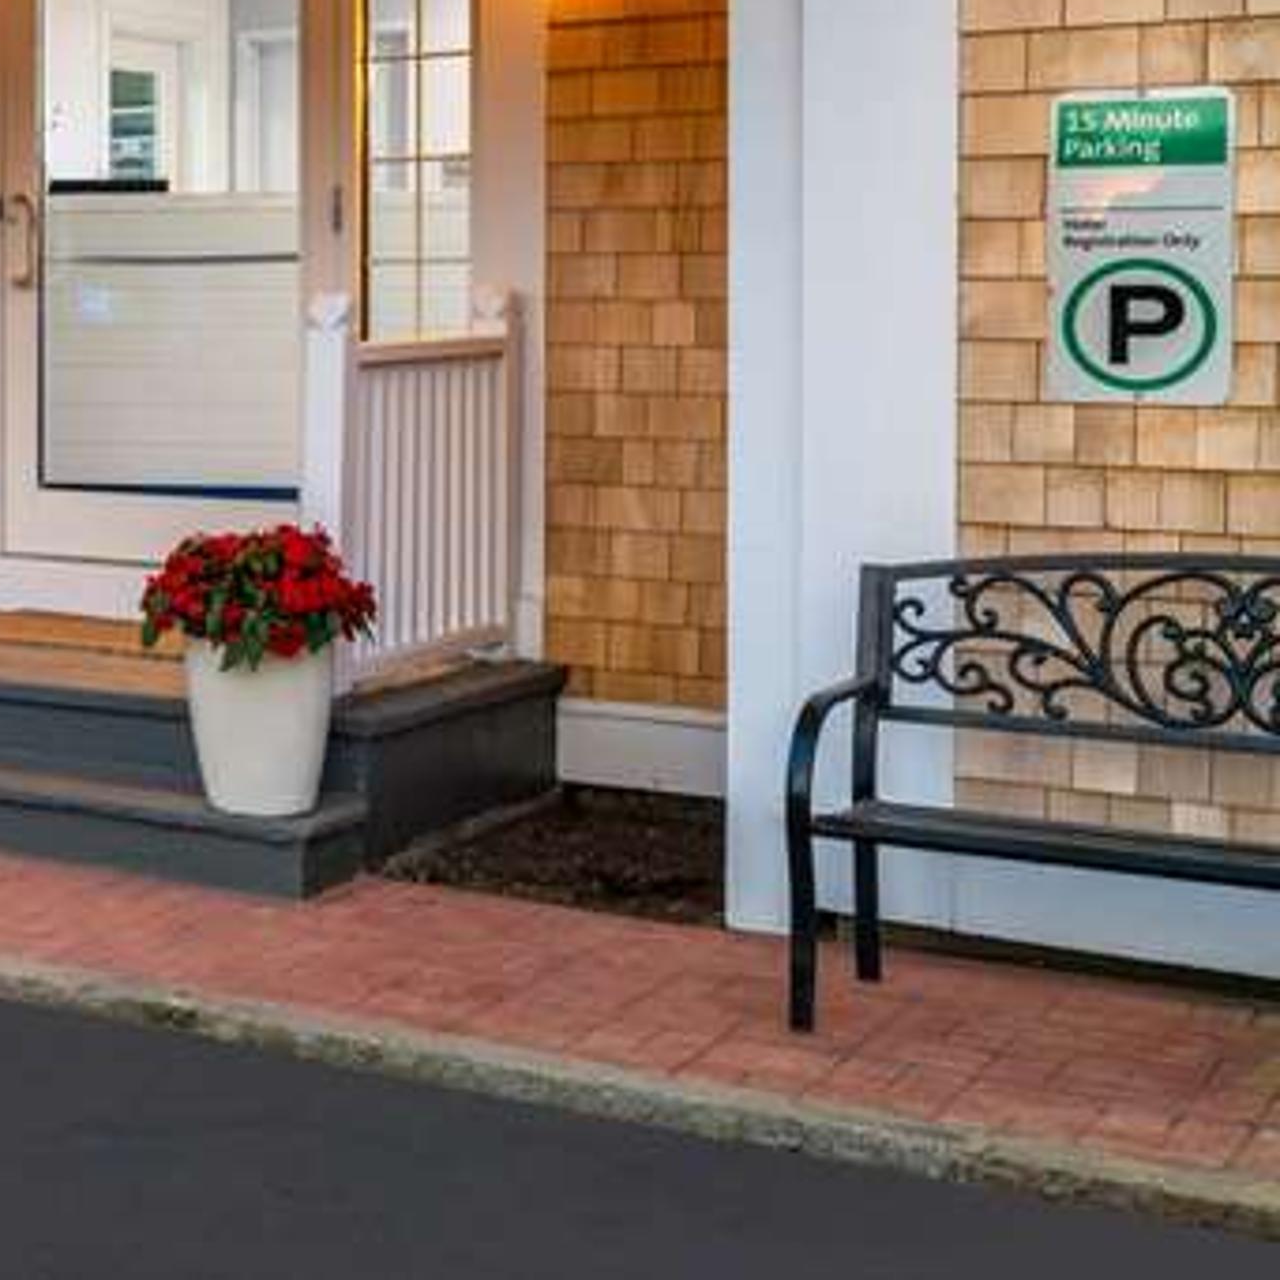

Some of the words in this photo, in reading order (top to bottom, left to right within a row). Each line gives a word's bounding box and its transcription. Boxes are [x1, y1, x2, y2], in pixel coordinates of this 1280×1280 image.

[1066, 109, 1096, 132] 15
[1104, 108, 1200, 132] Minute
[1064, 138, 1162, 162] Parking
[1163, 231, 1200, 251] Only
[1109, 285, 1184, 364] P
